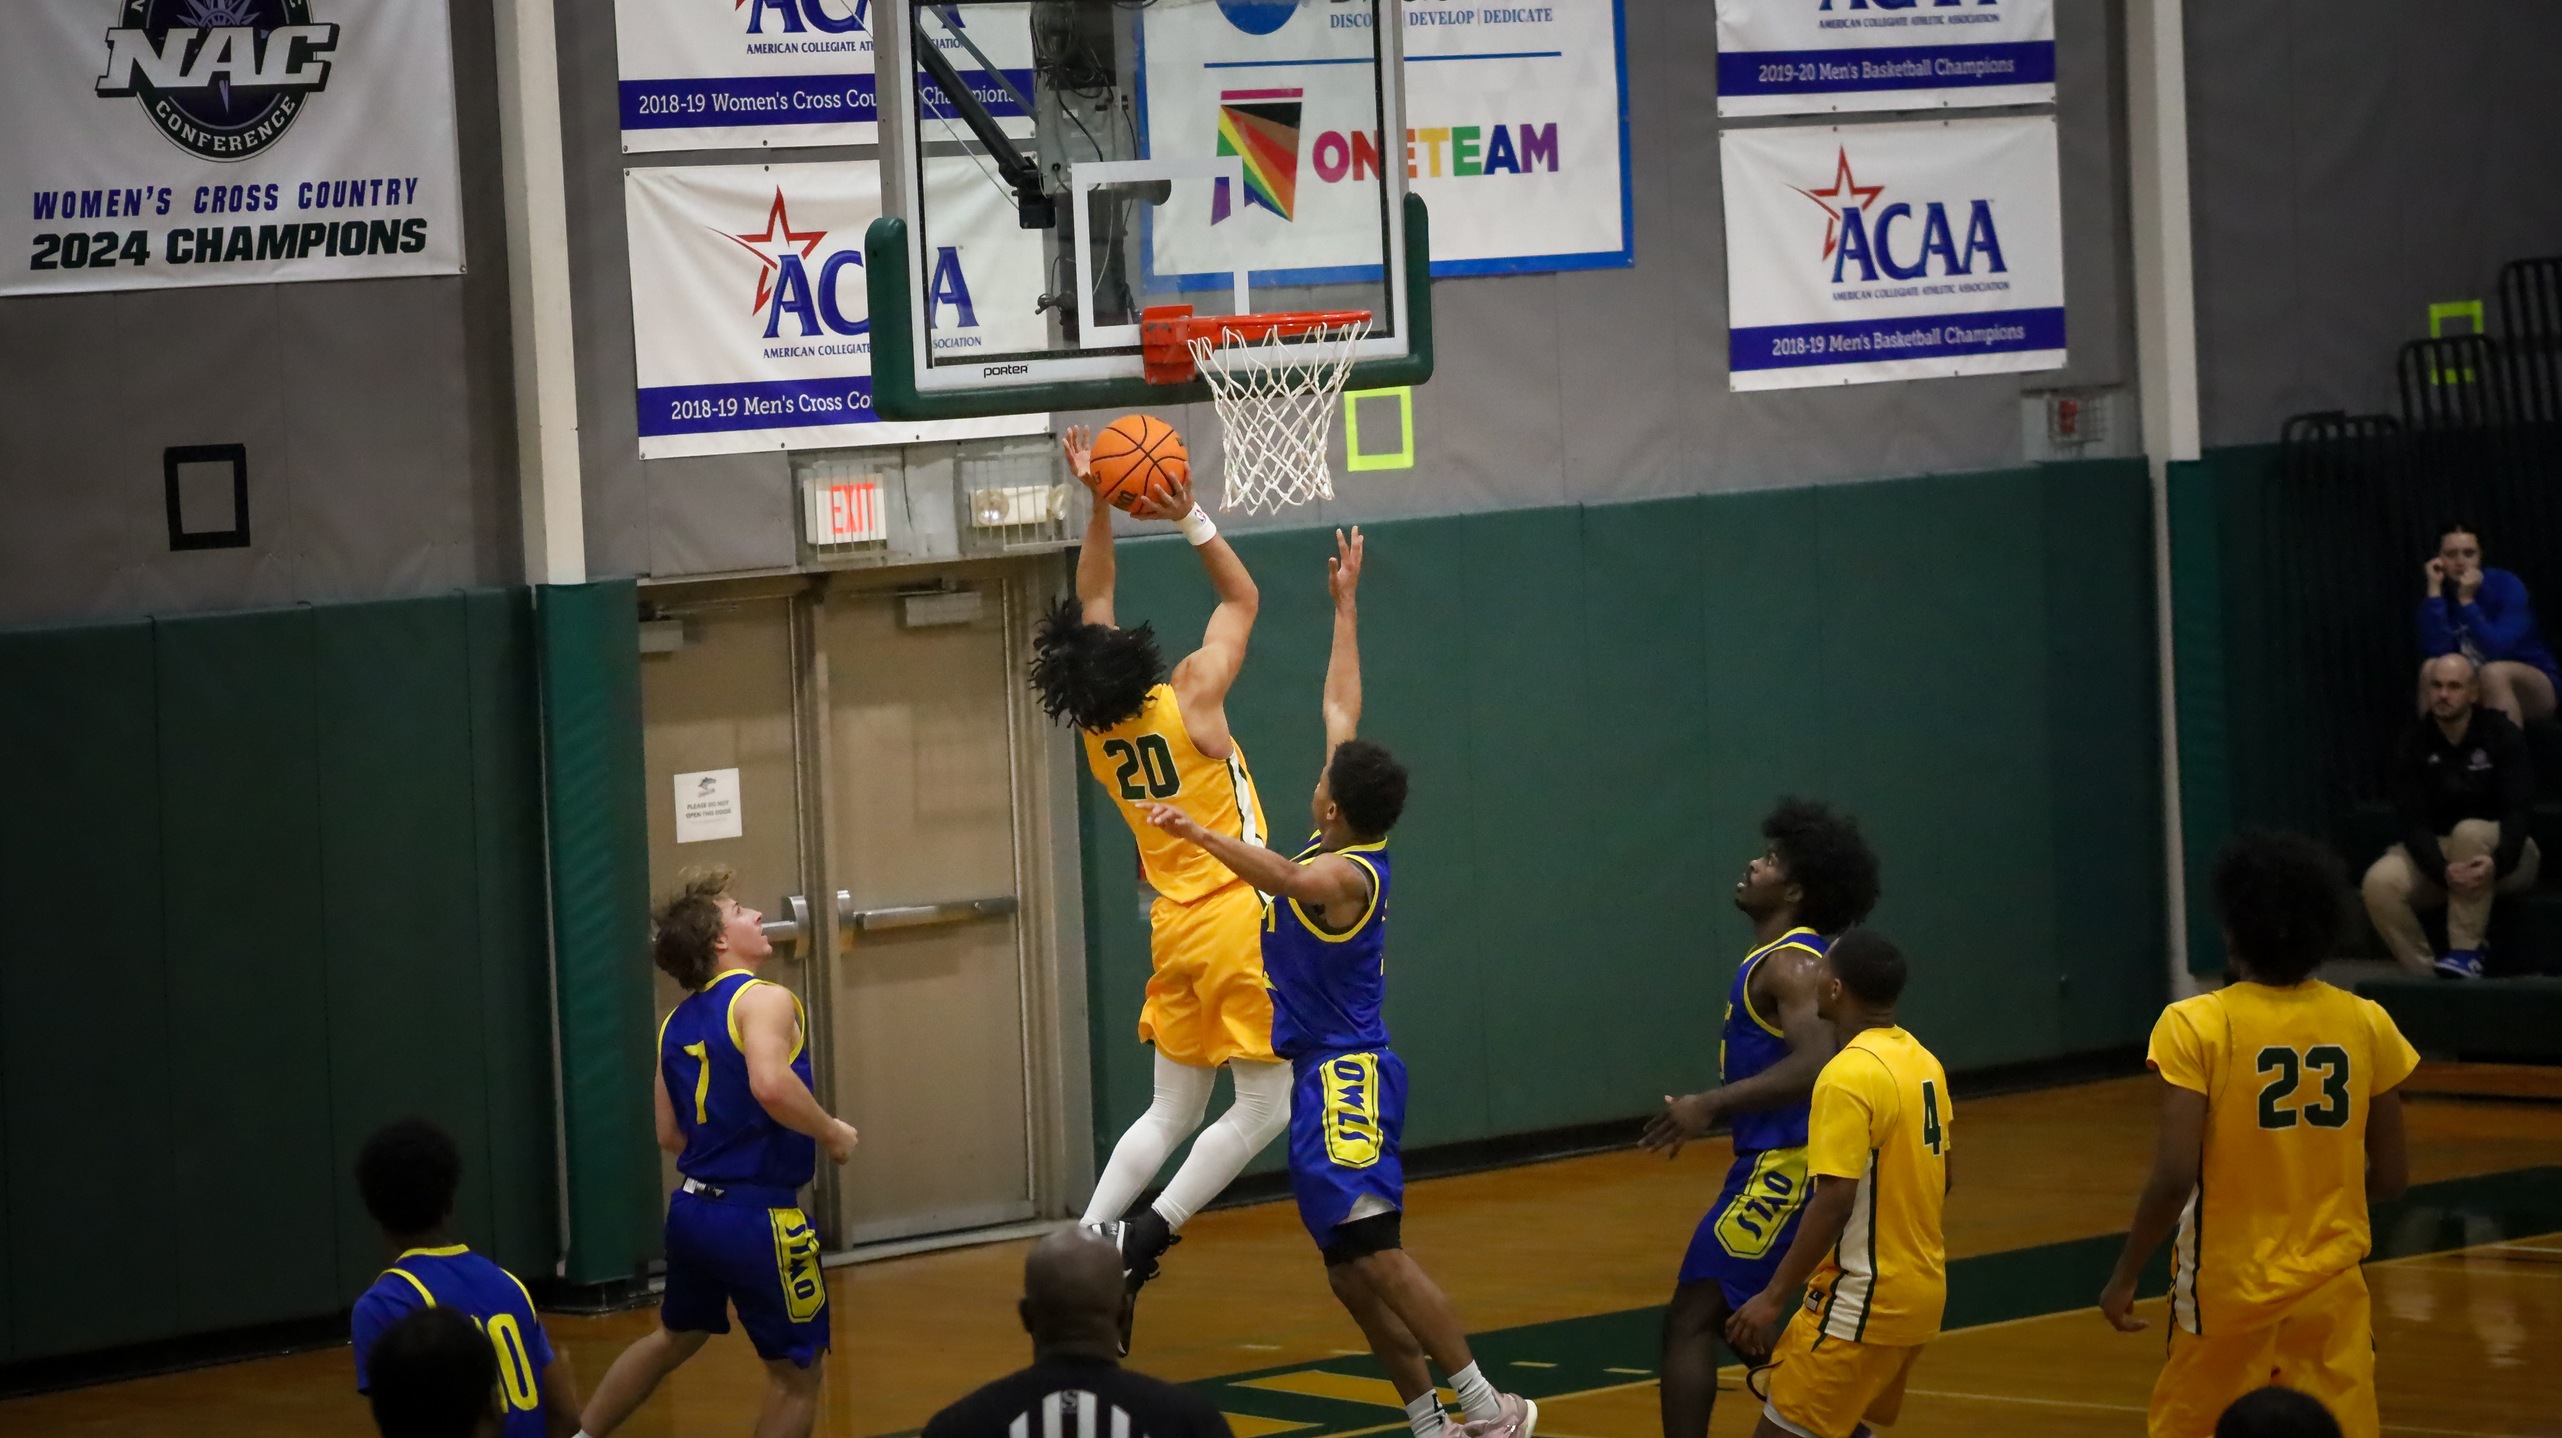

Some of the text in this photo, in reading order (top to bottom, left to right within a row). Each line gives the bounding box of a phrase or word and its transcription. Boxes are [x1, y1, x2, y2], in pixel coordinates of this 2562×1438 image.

[1330, 8, 1553, 28] DISCO DEVELOP DEDICATE
[97, 23, 334, 91] NAC
[746, 43, 798, 54] AMERICAN
[801, 41, 856, 53] COLLEGIATE
[1758, 57, 2015, 82] 2019-20 Men's Basketball Champions
[156, 95, 296, 151] CONFERENCE
[639, 94, 706, 114] 2018-19
[712, 91, 788, 112] Women's
[793, 90, 842, 110] Cross
[33, 177, 419, 220] WOMEN'S CROSS COUNTRY
[30, 217, 428, 271] 2024 CHAMPIONS
[1831, 199, 2008, 283] ACAA
[762, 246, 980, 339] ACA
[763, 343, 870, 359] AMERICAN COLLEGIATE
[932, 336, 982, 349] SOCIATION
[1772, 323, 2026, 357] 2018-19 Men's Basketball Champions
[671, 397, 738, 420] 2018-19
[743, 395, 794, 416] Men's
[798, 393, 843, 413] Cross
[829, 482, 875, 534] EXIT
[1102, 732, 1181, 801] 20
[683, 1040, 709, 1125] 7
[1333, 1060, 1371, 1146] OWLS
[2255, 1043, 2350, 1131] 23
[1922, 1079, 1942, 1157] 4
